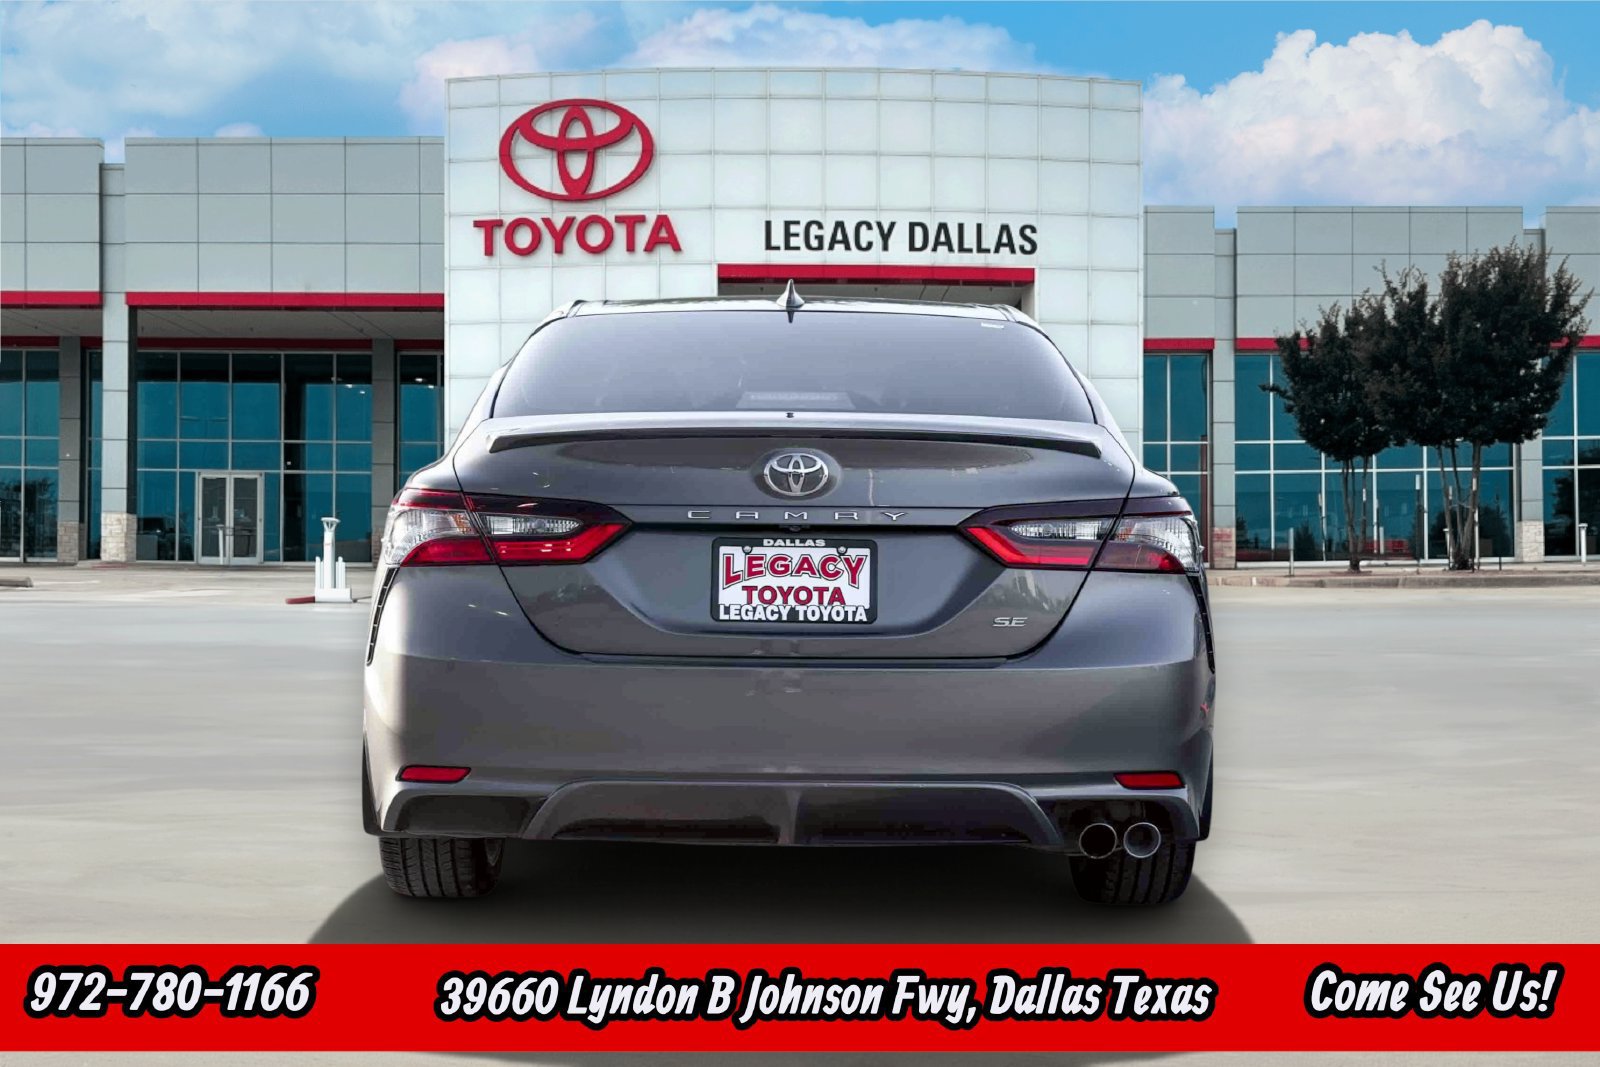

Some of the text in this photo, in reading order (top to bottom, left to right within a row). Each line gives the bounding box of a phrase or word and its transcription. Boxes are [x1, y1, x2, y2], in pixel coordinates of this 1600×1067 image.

[474, 214, 682, 257] TOYOTA
[765, 219, 1038, 255] LEGACY DALLAS
[687, 510, 907, 521] CAMRY
[763, 538, 826, 547] DALLAS
[723, 553, 868, 590] LEGACY
[742, 585, 846, 605] TOYOTA
[719, 604, 868, 622] LEGACY TOYOTA
[992, 616, 1028, 627] SE
